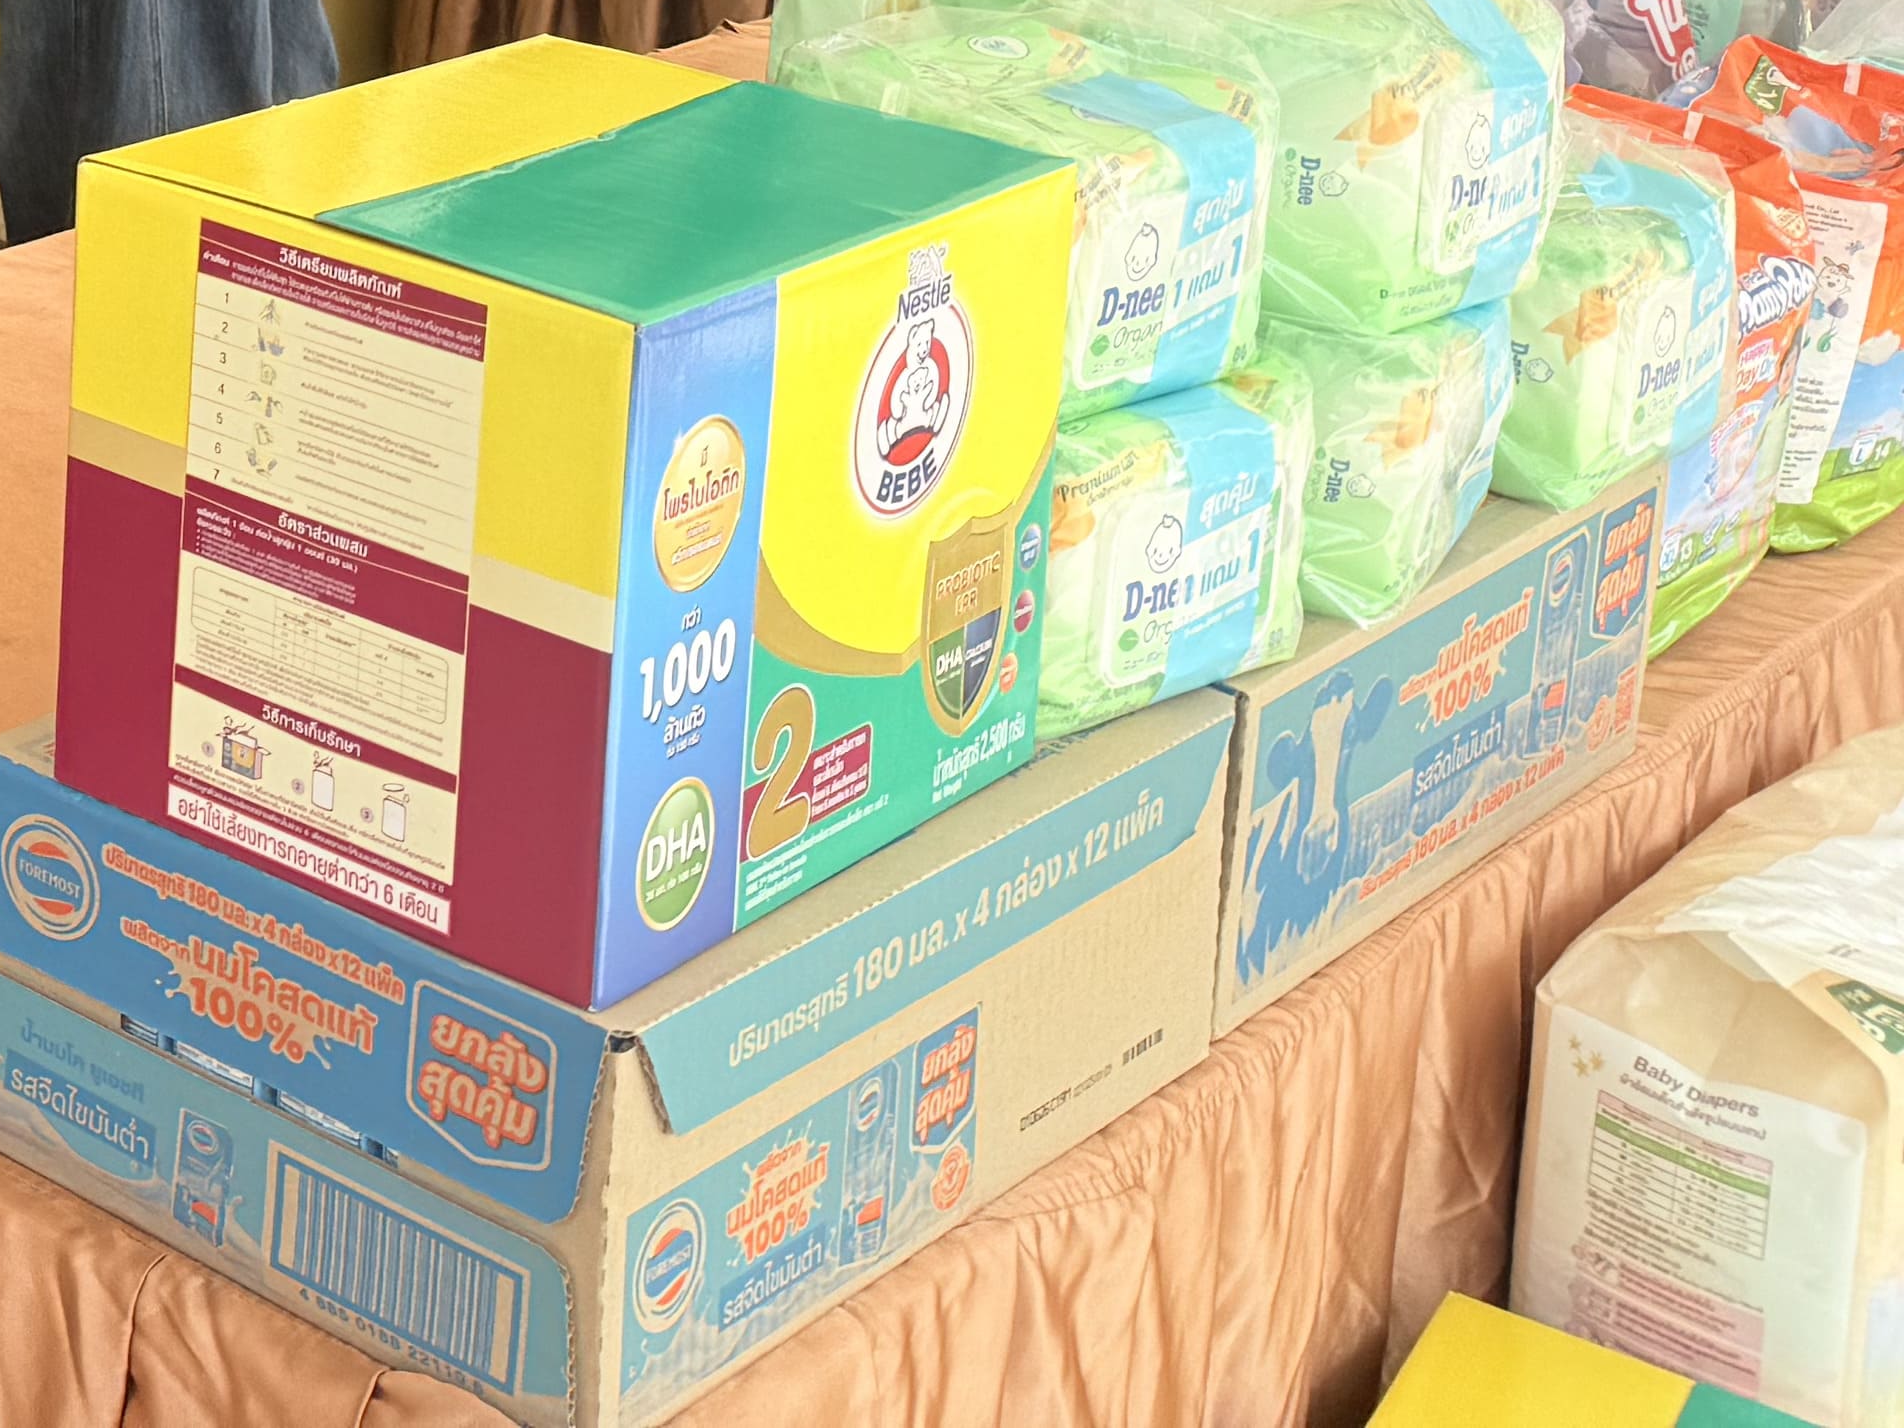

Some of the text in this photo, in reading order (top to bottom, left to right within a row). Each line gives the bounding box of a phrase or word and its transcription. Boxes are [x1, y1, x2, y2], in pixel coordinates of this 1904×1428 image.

[1297, 155, 1322, 207] D-nee
[1531, 153, 1543, 200] 1
[223, 292, 230, 305] 1
[278, 247, 402, 300] วิธีเตรียมผลิตภัณฑ์
[897, 274, 953, 326] Nestlé
[1173, 234, 1244, 310] 1 แถม 1
[221, 321, 229, 335] 2
[1096, 282, 1166, 328] D-nee
[1112, 319, 1164, 353] Organ
[218, 382, 226, 395] 4
[219, 352, 227, 365] 3
[1637, 356, 1682, 400] D-nee
[214, 442, 222, 455] 6
[216, 412, 224, 425] 5
[213, 468, 220, 481] 7
[663, 467, 740, 522] โพรไบโอติก
[876, 448, 940, 507] BEBE
[1323, 457, 1352, 504] D-nee
[277, 509, 368, 558] อัตราส่วนผสม
[1199, 556, 1241, 598] แถม
[1247, 527, 1261, 574] 1
[1606, 504, 1654, 566] ยกลัง
[1595, 553, 1647, 632] สุดคุ้ม
[936, 644, 964, 678] DHA
[1437, 590, 1534, 677] นมโคสดแท้
[640, 617, 737, 725] 1,000
[1432, 662, 1493, 726] 100%
[261, 704, 362, 758] วิธีการเก็บรักษา
[1415, 710, 1504, 799] รสจืดไขมันต่ำ
[747, 683, 816, 862] 2
[1414, 833, 1438, 860] 180
[1469, 803, 1481, 824] 4
[1523, 765, 1538, 790] 12
[177, 795, 438, 924] อย่าใช้เลี้ยงทารกอายุต่ำกว่า 6 เดือน
[645, 811, 708, 884] DHA
[18, 859, 82, 901] FOREMOST
[103, 841, 186, 901] ปริมาตรสุทธิ
[186, 879, 221, 914] 180
[262, 915, 278, 942] 4
[277, 920, 328, 964] กล่อง
[339, 948, 362, 981] 12
[122, 915, 192, 965] ผลิตจาก
[729, 790, 1164, 1068] ปริมาตรสุทธิ 180 มล. x 4 กล่อง x 12 แพ็ค
[190, 937, 380, 1055] นมโคสดแท้
[190, 975, 306, 1064] 100%
[429, 1011, 550, 1093] ยกลัง
[922, 1024, 977, 1087] ยกลัง
[10, 1066, 150, 1161] รสจืดไขมันต่ำ
[417, 1057, 539, 1149] สุดคุ้ม
[914, 1070, 971, 1146] สุดคุ้ม
[1633, 1054, 1761, 1119] Baby Diapers
[726, 1143, 830, 1238] นมโคสดแท้
[742, 1200, 811, 1264] 100%
[722, 1232, 824, 1326] รสจืดไขมันต่ำ
